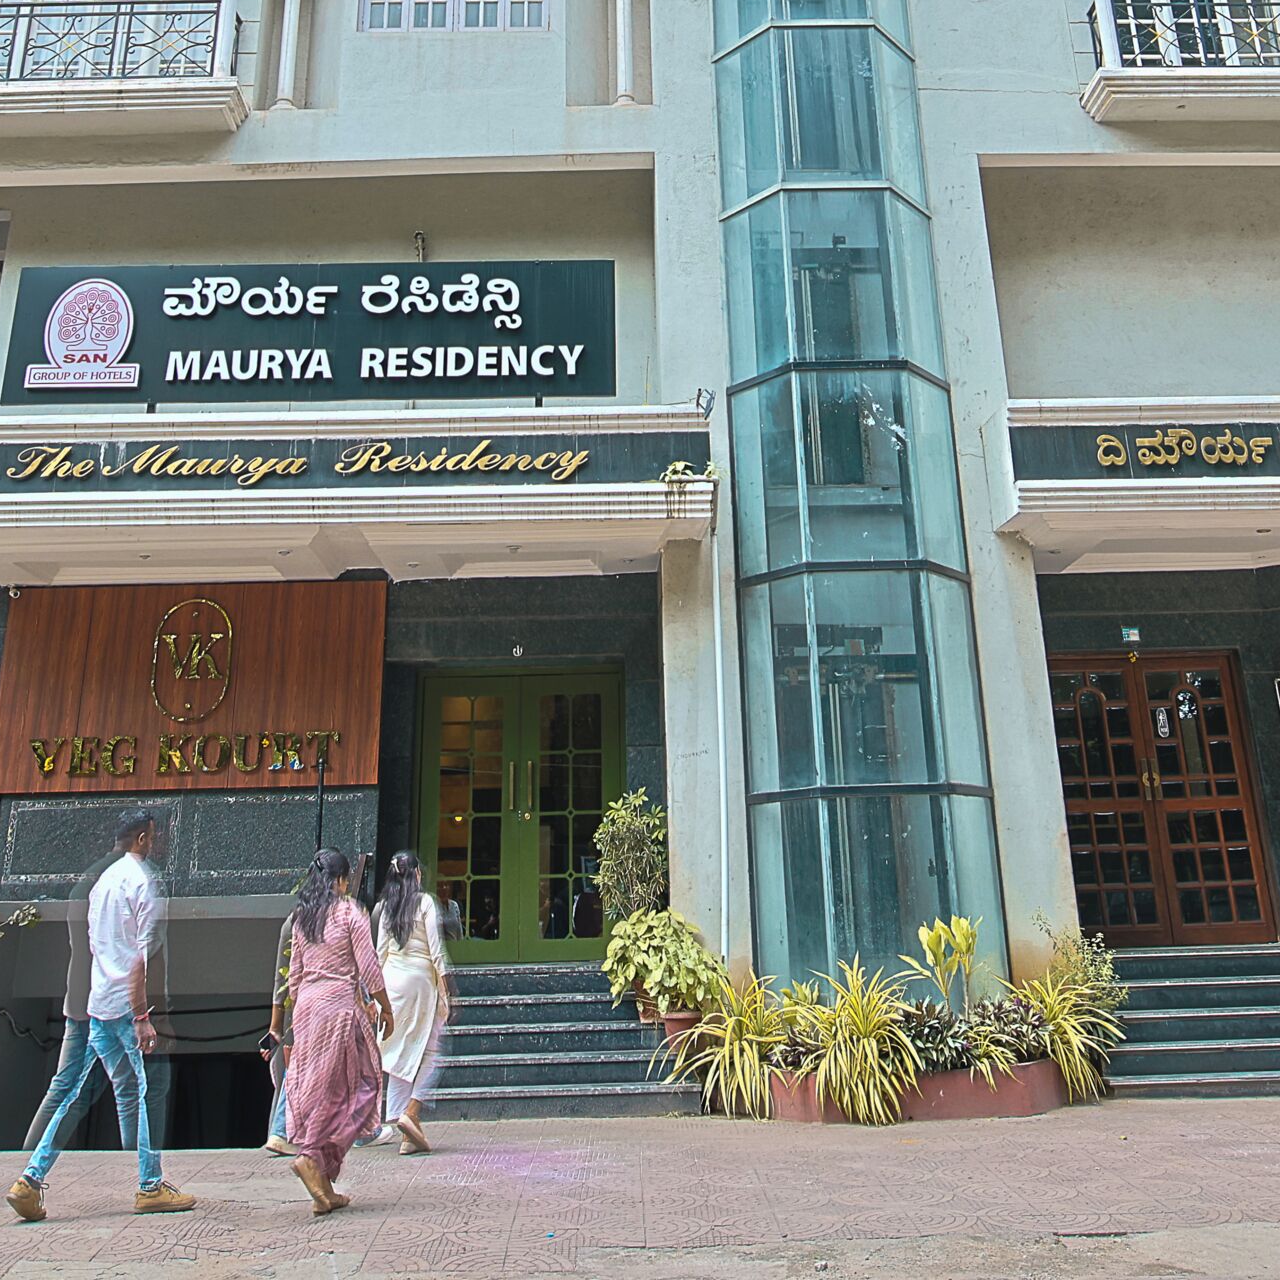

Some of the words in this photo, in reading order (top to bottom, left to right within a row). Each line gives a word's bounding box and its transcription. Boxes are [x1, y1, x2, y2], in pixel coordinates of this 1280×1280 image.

[163, 276, 338, 316] ಮೌರ್ಯ
[361, 274, 523, 329] ರೆಸಿಡೆನ್ಸಿ
[31, 371, 72, 383] GROUP
[74, 371, 88, 382] OF
[90, 369, 133, 381] HOTELS
[63, 353, 108, 364] SAN
[165, 348, 334, 381] MAURYA
[360, 344, 585, 378] RESIDENCY
[6, 446, 96, 481] The
[102, 444, 309, 486] Maurya
[335, 437, 590, 484] Residency
[1096, 434, 1128, 466] ದಿ
[1136, 428, 1273, 466] ಮೌರ್ಯ
[162, 633, 225, 679] VK
[29, 735, 137, 778] VEG
[155, 731, 342, 774] KOURT
